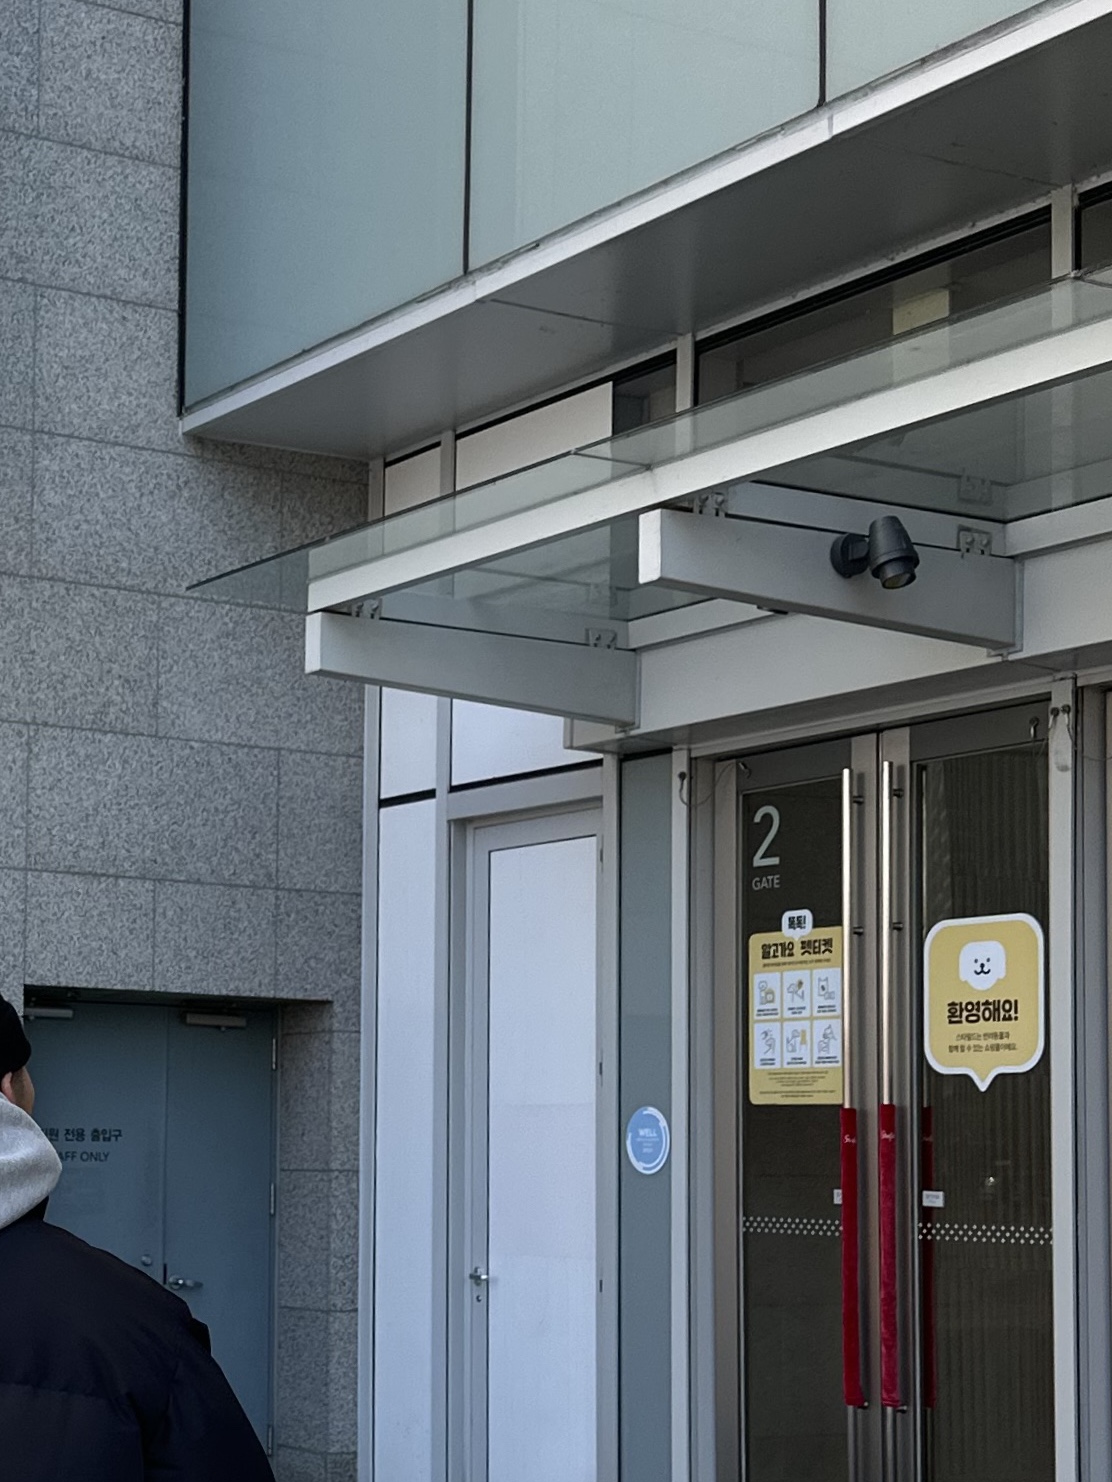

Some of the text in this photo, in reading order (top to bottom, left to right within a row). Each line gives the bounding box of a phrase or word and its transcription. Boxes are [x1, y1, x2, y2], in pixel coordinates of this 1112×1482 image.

[753, 805, 780, 867] 2
[752, 875, 780, 890] GATE
[761, 938, 833, 960] 알고가요 펫티켓
[947, 999, 1019, 1025] 환영해요!
[64, 1128, 85, 1142] 전용
[91, 1128, 123, 1142] 출입구
[59, 1151, 110, 1162] AFF ONLY
